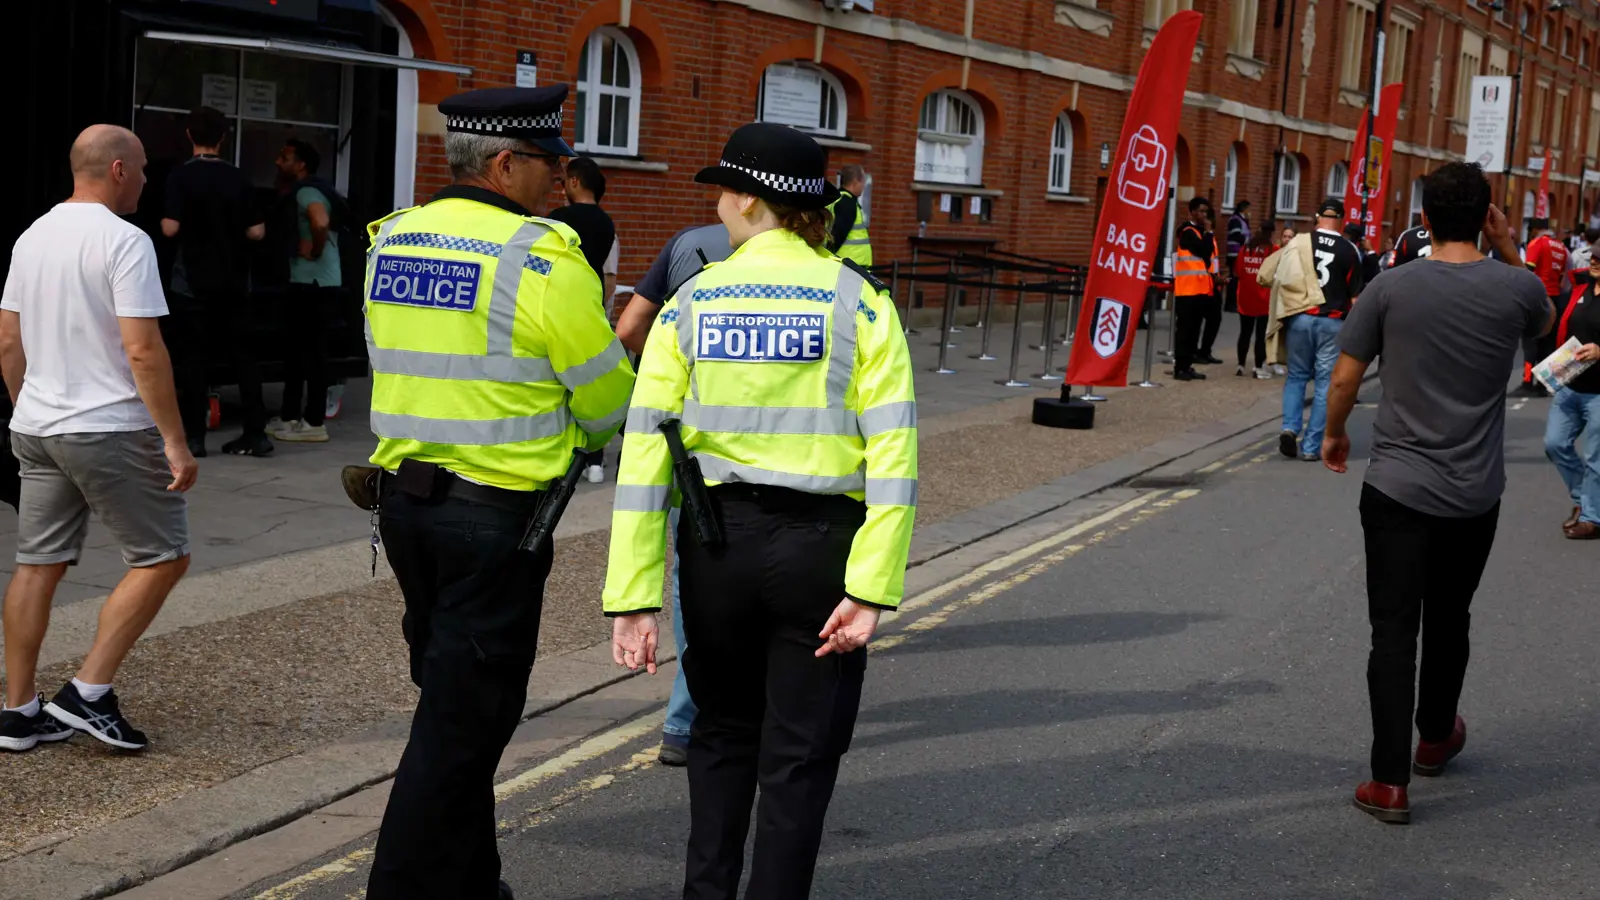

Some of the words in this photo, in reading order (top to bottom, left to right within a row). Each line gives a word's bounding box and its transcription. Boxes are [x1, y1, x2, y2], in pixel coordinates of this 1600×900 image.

[1106, 223, 1147, 253] BAG
[1318, 235, 1336, 247] STU
[380, 259, 476, 279] METROPOLITAN
[1096, 247, 1150, 281] LANE
[1315, 248, 1336, 288] 3
[374, 274, 474, 306] POLICE
[702, 315, 821, 327] METROPOLITAN
[700, 328, 821, 358] POLICE
